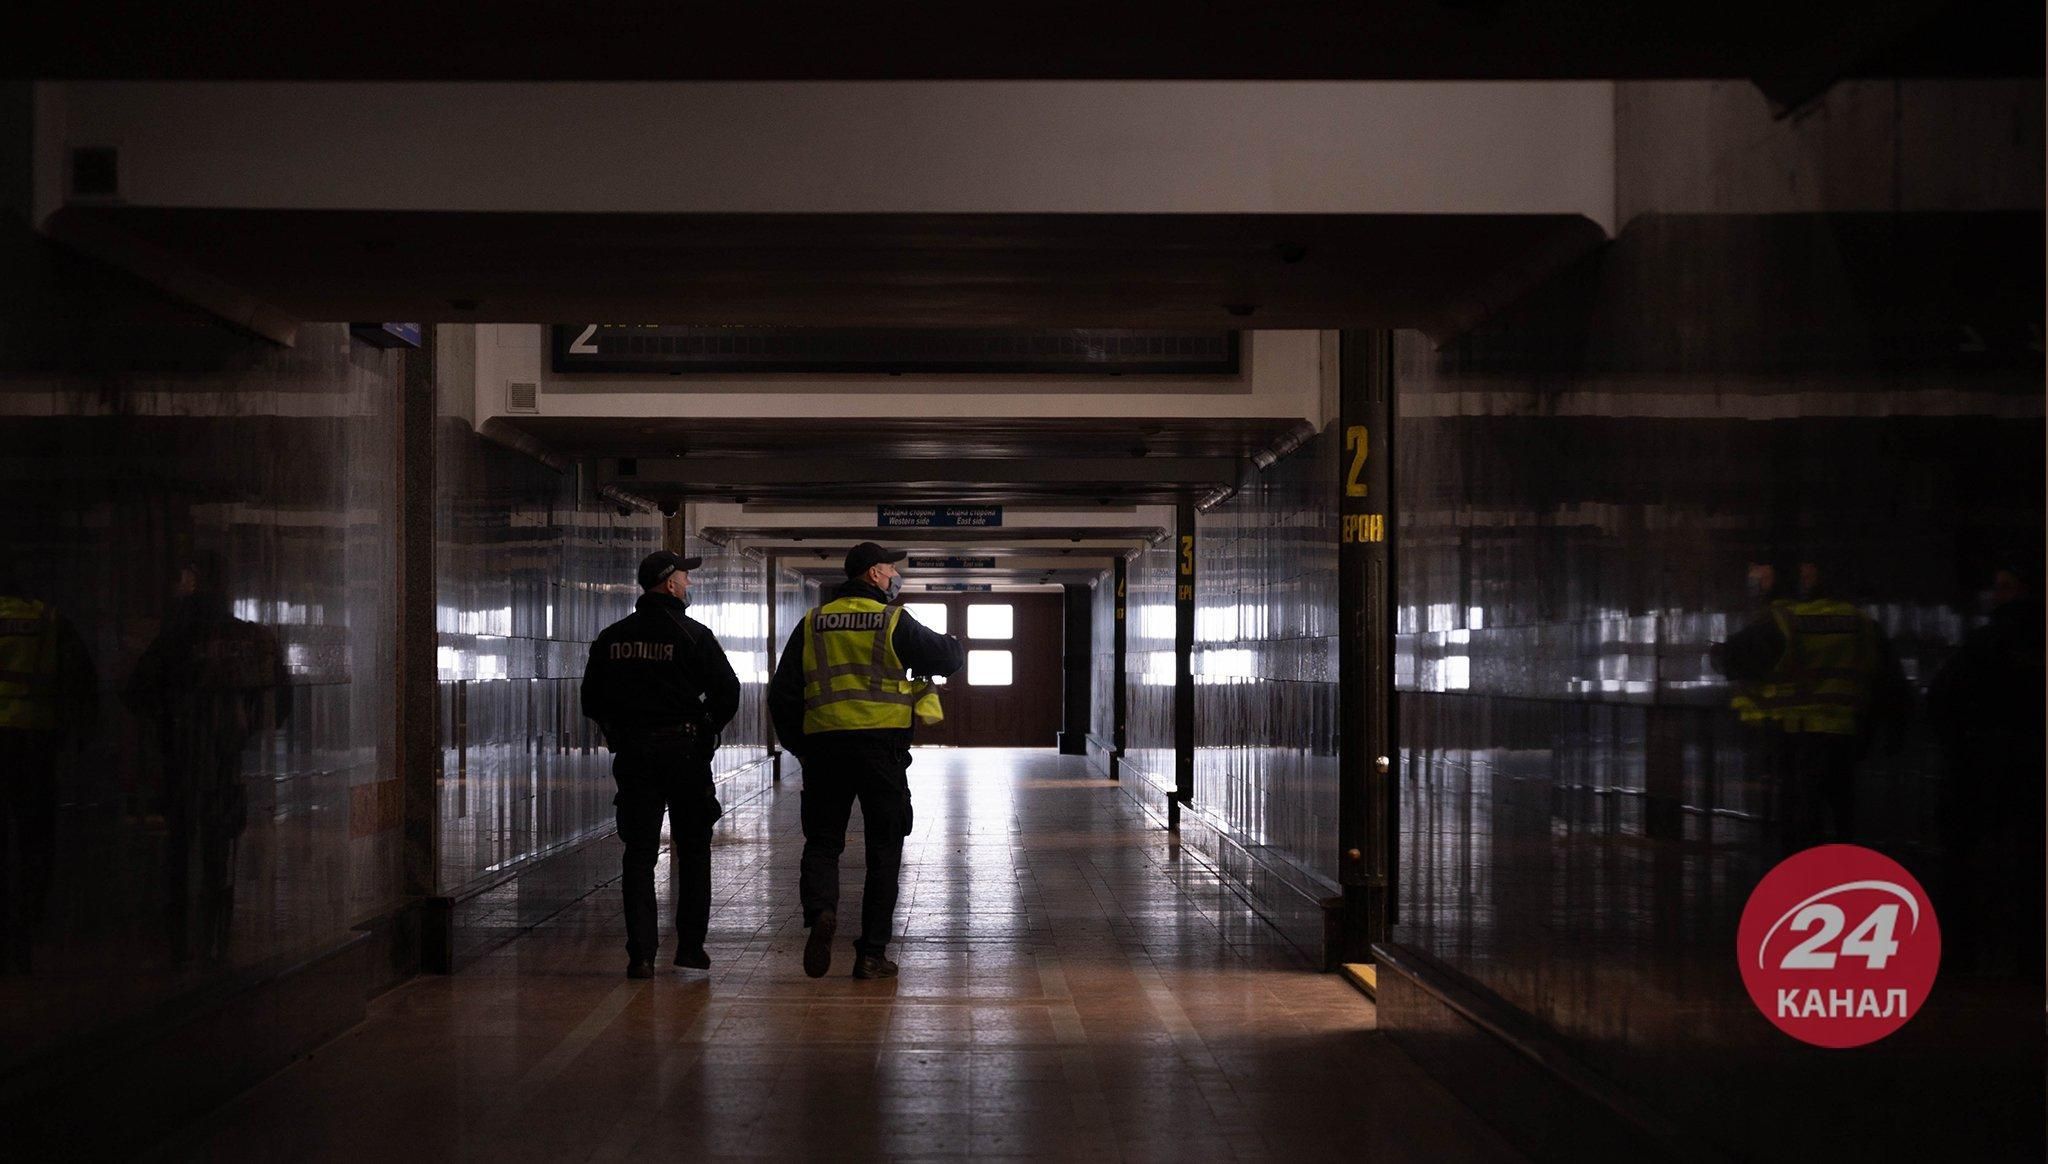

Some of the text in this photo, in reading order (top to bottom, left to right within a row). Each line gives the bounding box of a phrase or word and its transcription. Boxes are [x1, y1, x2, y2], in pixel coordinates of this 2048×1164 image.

[568, 323, 598, 354] 2
[1346, 425, 1369, 498] 2
[889, 516, 930, 525] Western side
[956, 516, 986, 525] East side
[1180, 535, 1193, 576] 3
[817, 613, 884, 631] ПОЛІЦІЯ
[609, 641, 675, 661] ПОЛІЦІЯ
